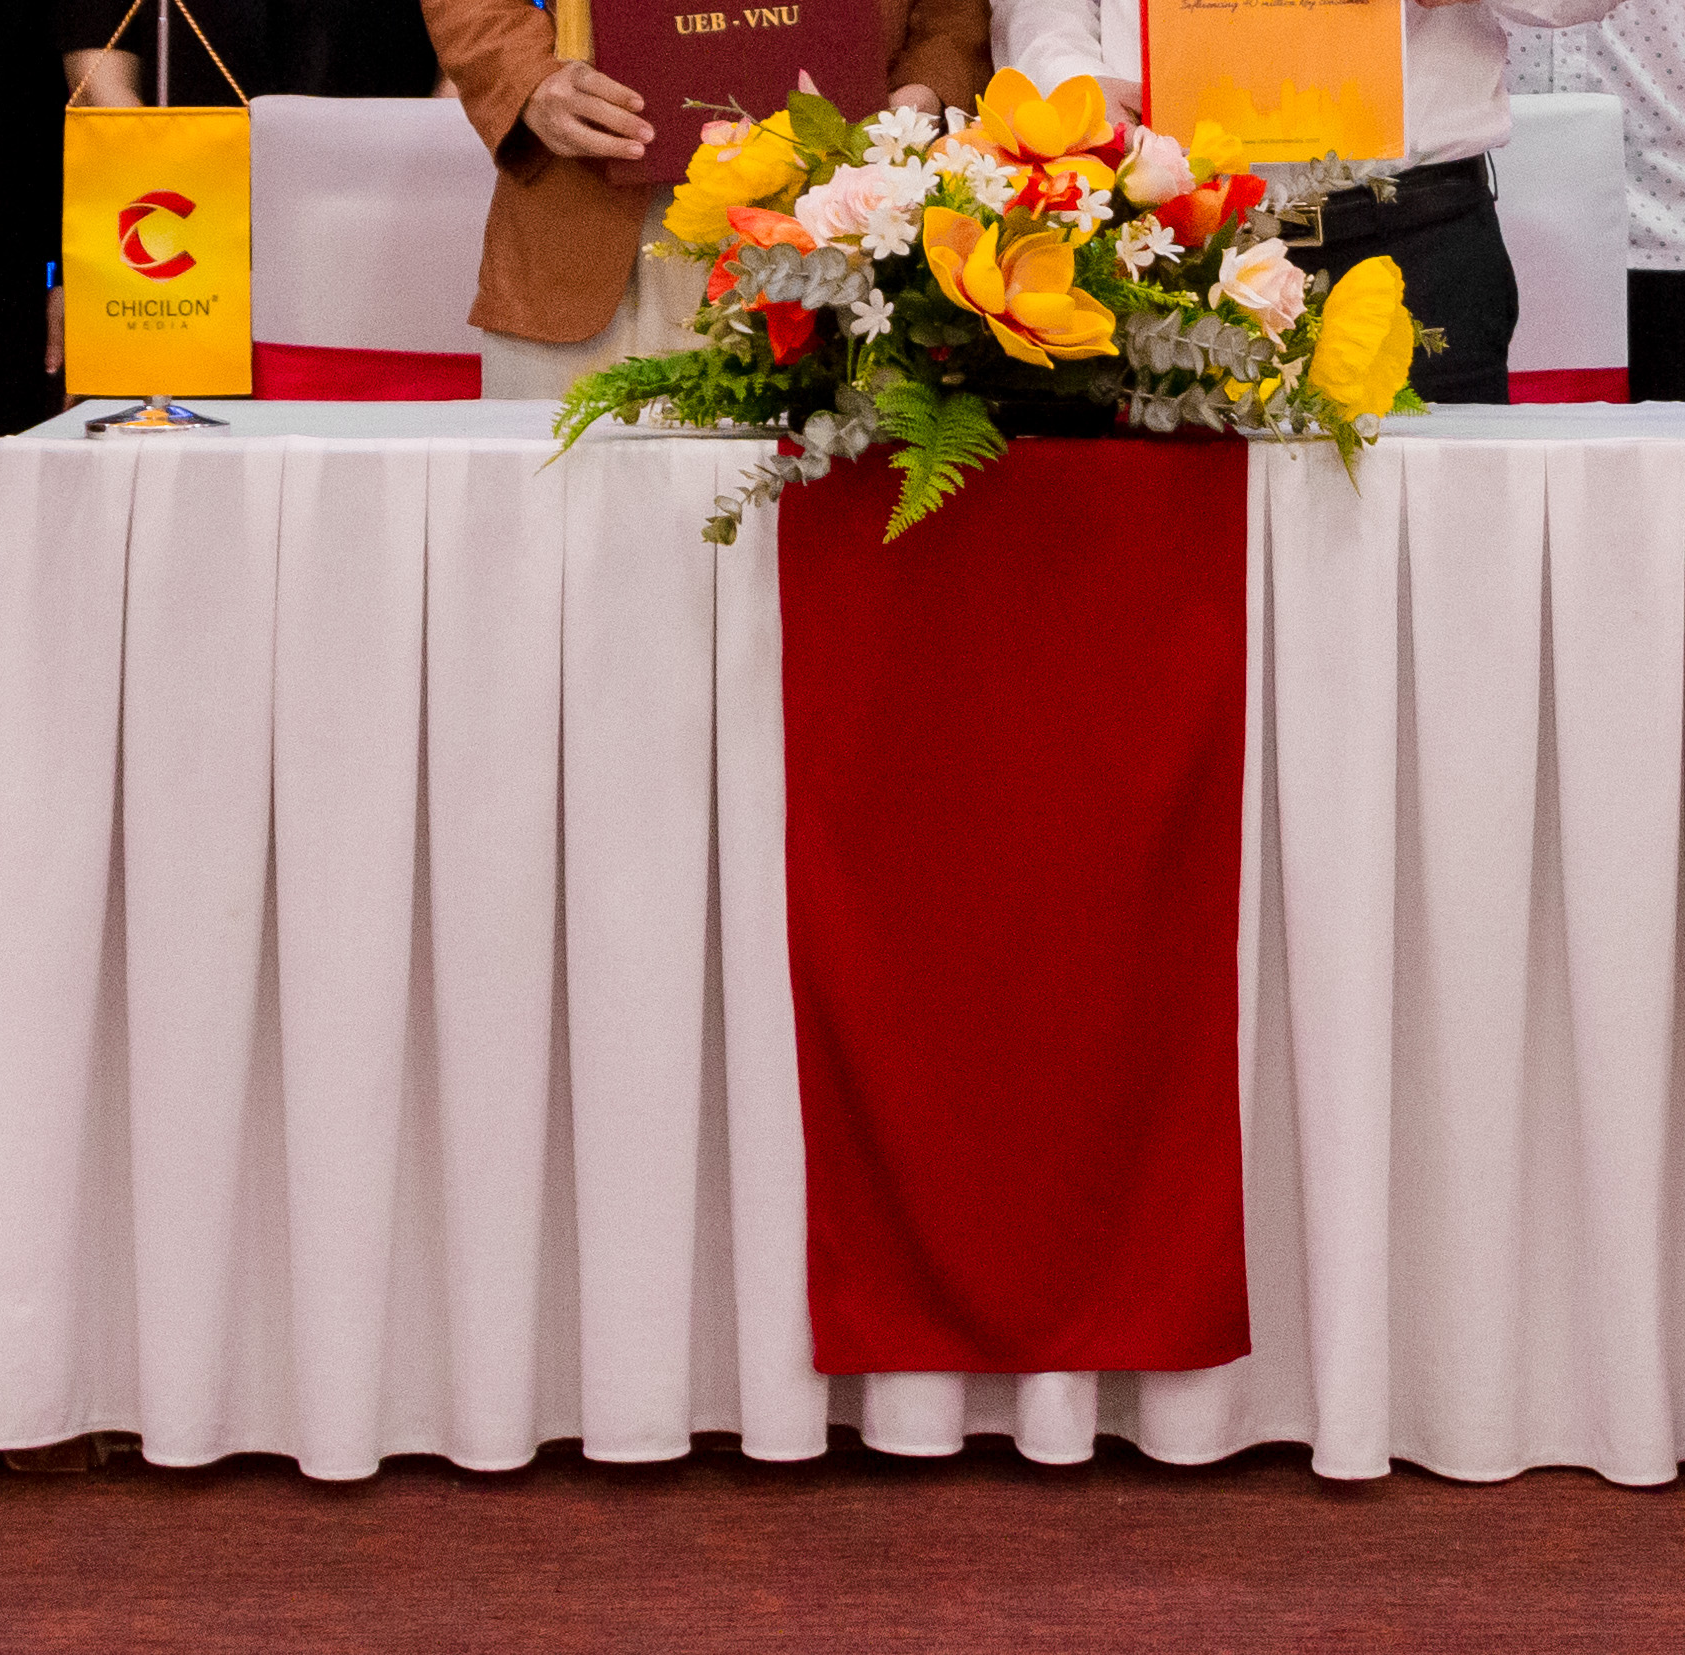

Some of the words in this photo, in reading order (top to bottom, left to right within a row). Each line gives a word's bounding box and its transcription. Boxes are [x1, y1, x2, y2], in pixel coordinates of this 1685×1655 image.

[674, 11, 727, 35] UEB
[742, 5, 800, 29] VNU
[105, 299, 210, 319] CHICILON
[126, 320, 189, 330] MEDIA
